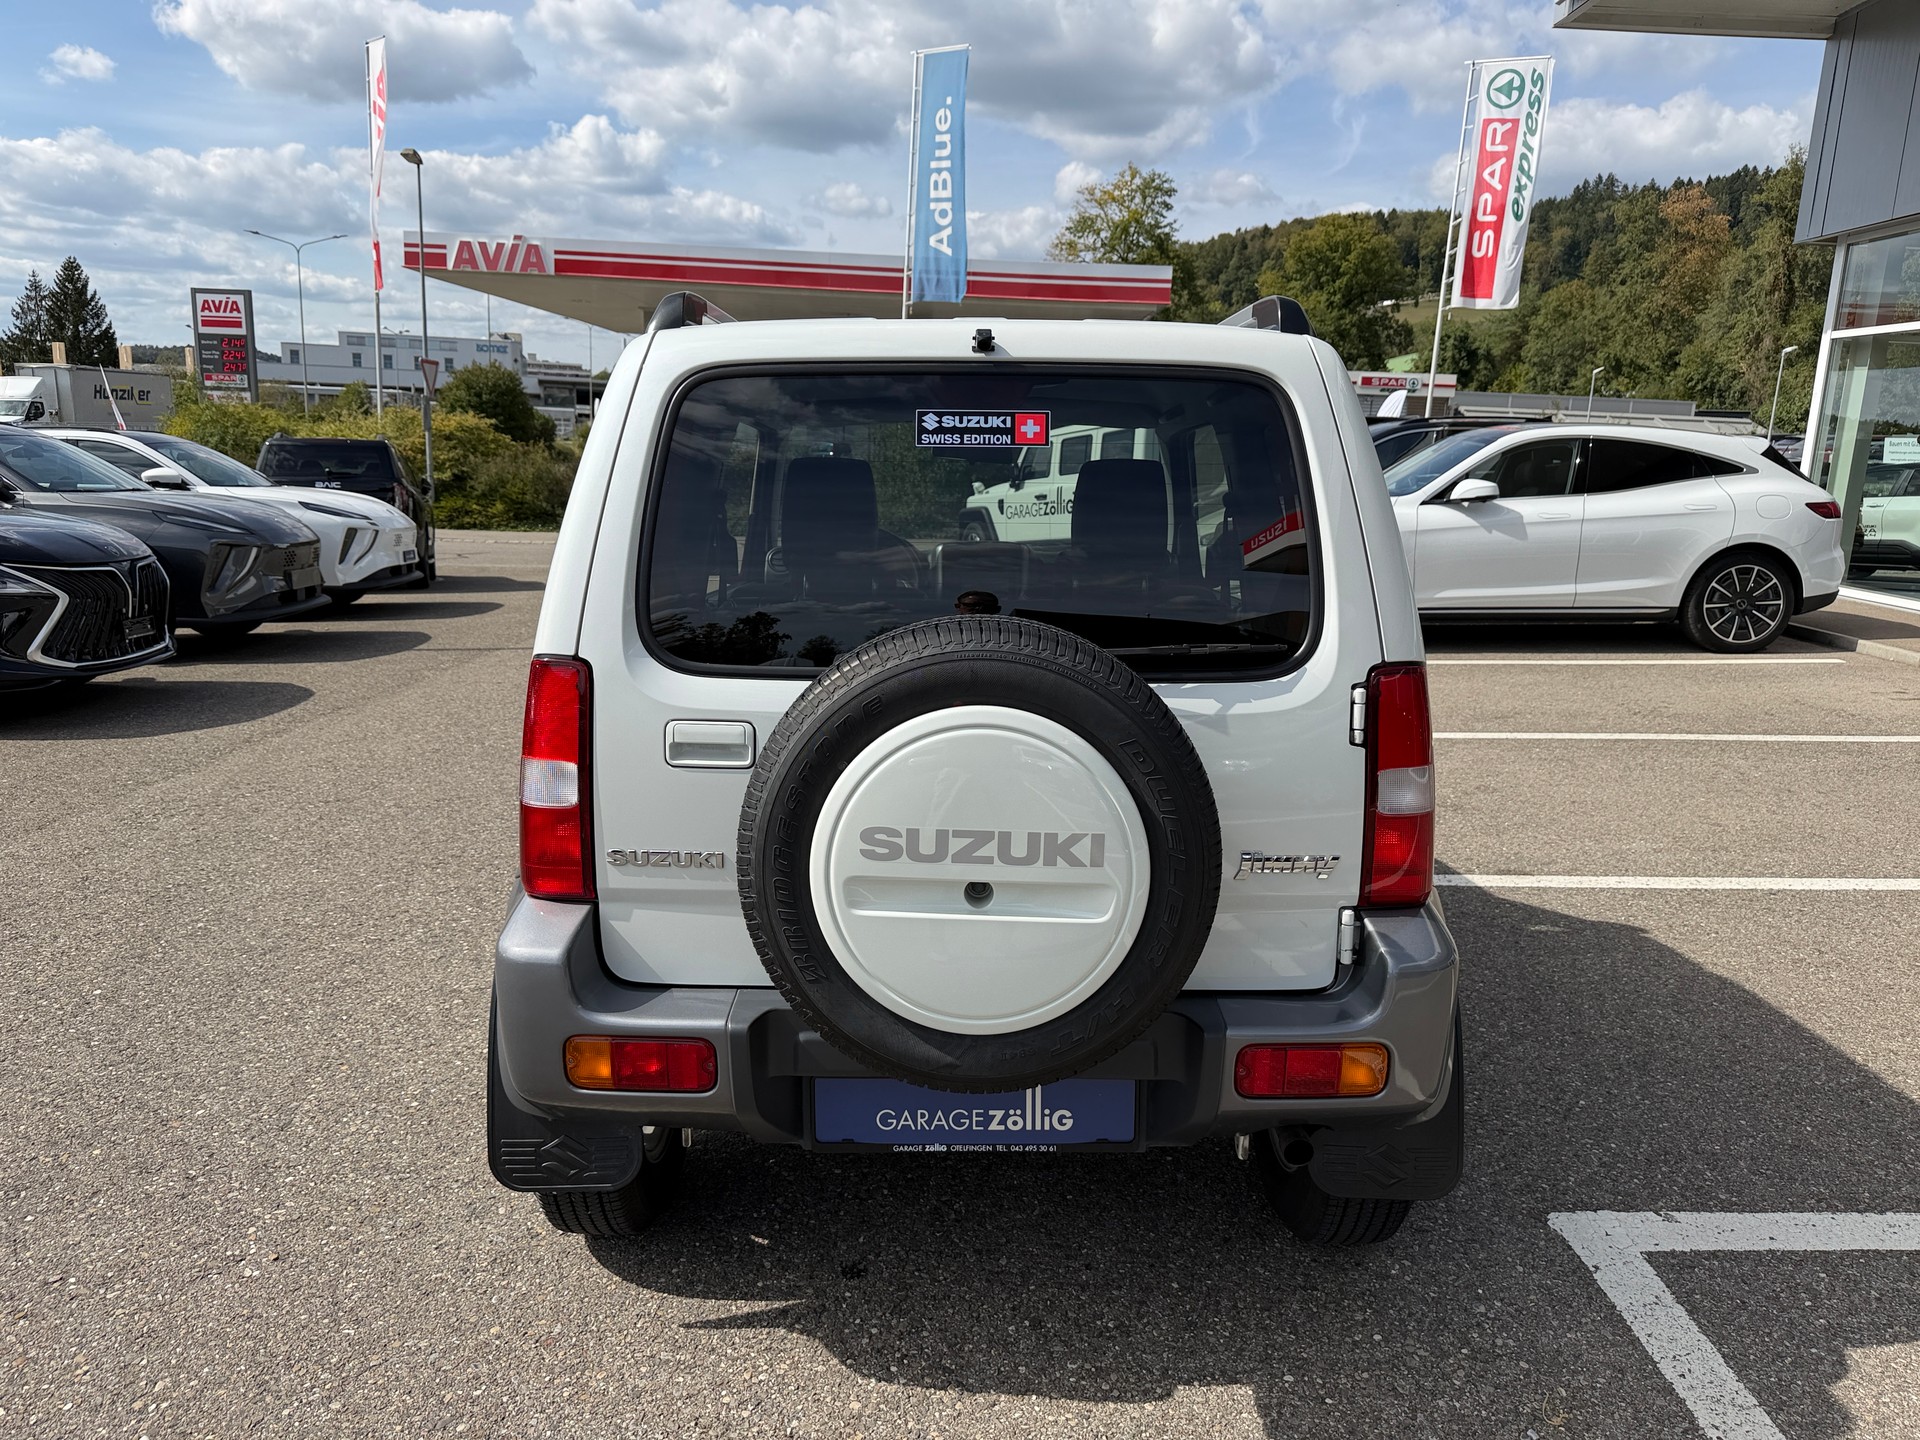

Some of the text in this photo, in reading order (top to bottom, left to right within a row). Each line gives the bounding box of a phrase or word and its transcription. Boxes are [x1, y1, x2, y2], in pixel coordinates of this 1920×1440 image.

[1511, 67, 1545, 222] express
[929, 96, 953, 257] AdBlue.
[1471, 121, 1513, 259] SPAR
[211, 374, 237, 382] SPAR
[1371, 378, 1406, 386] SPAR
[921, 434, 1011, 445] SWISS EDITION
[941, 415, 1012, 428] SUZUKI
[606, 848, 725, 869] SUZUKI
[771, 694, 883, 985] BRIDGESTONE
[859, 826, 1106, 868] SUZUKI
[1118, 738, 1187, 968] DUELER
